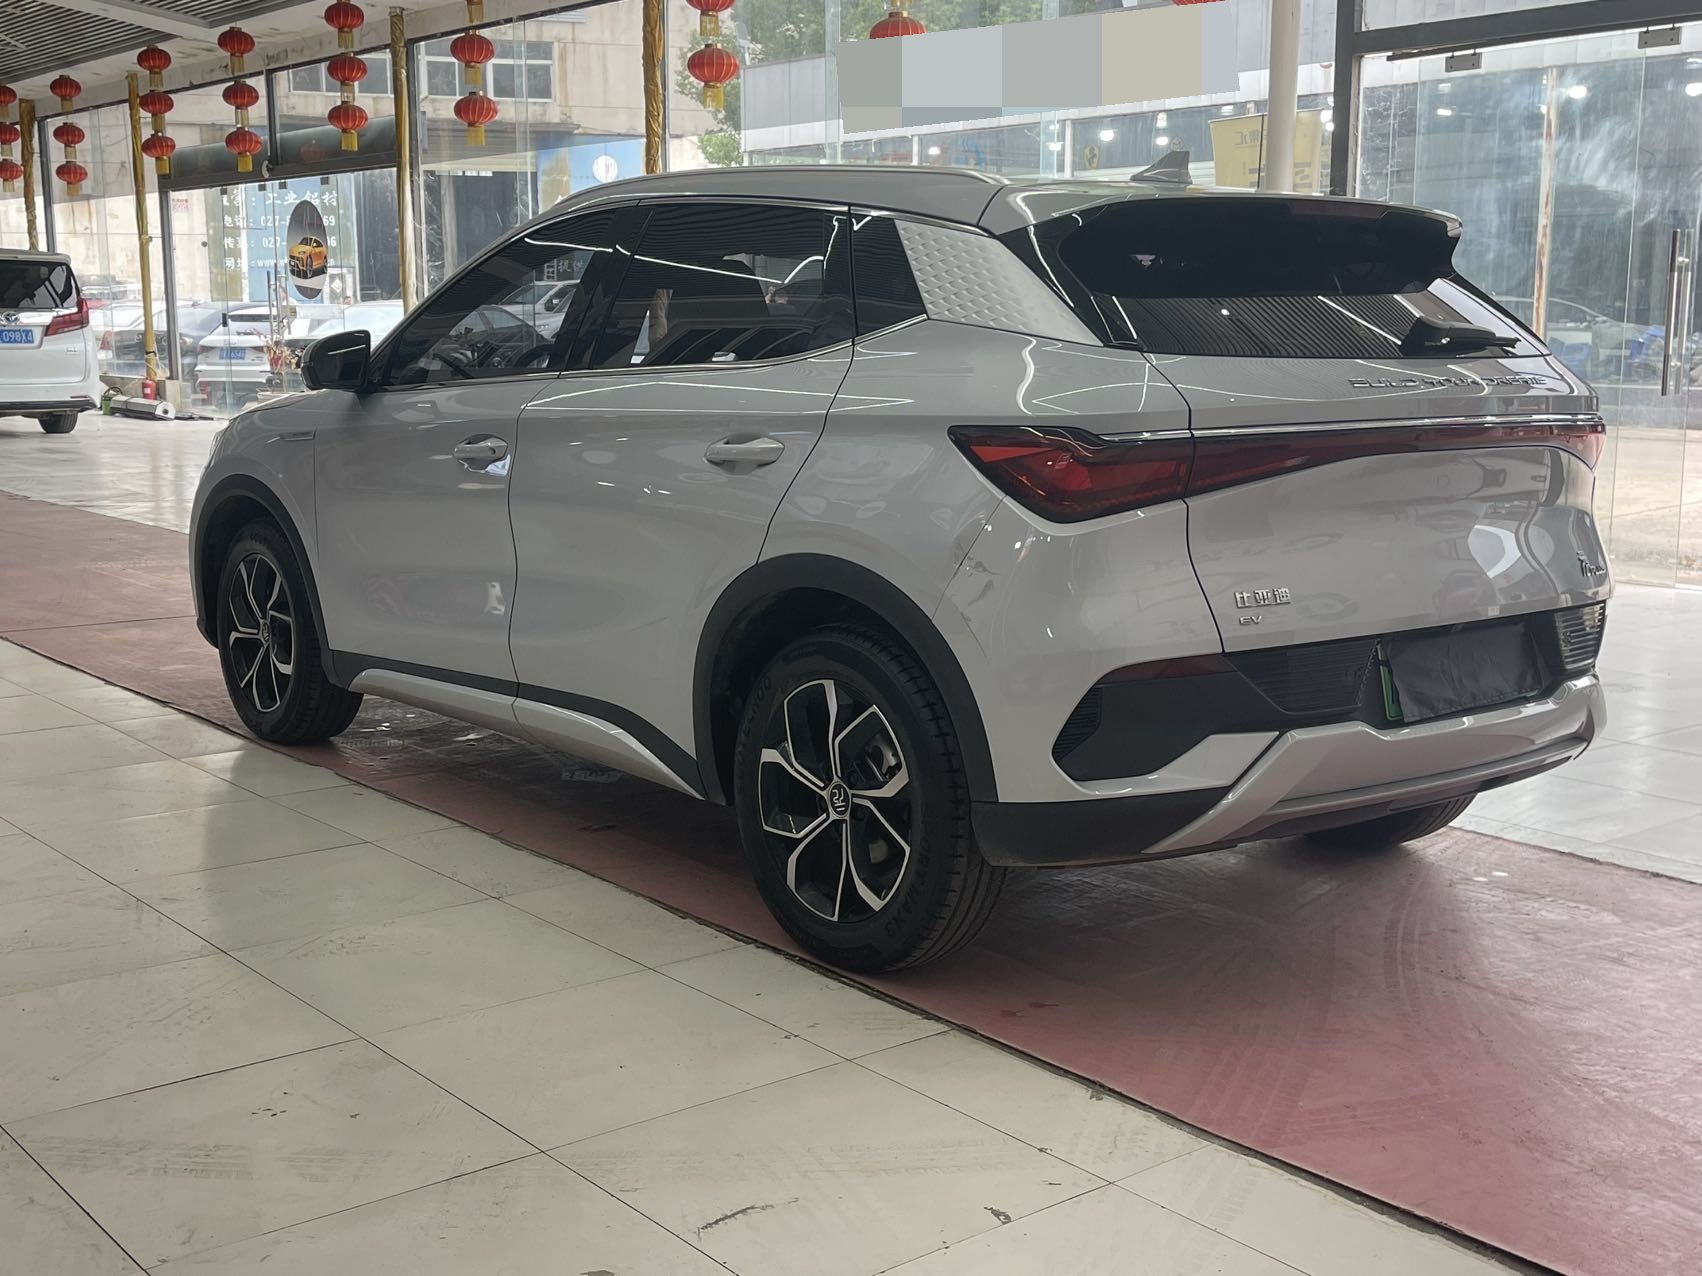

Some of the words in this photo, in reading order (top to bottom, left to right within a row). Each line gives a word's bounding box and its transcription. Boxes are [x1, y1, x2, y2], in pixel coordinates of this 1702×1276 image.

[1234, 587, 1290, 608] 比亚迪
[1239, 615, 1262, 625] EV
